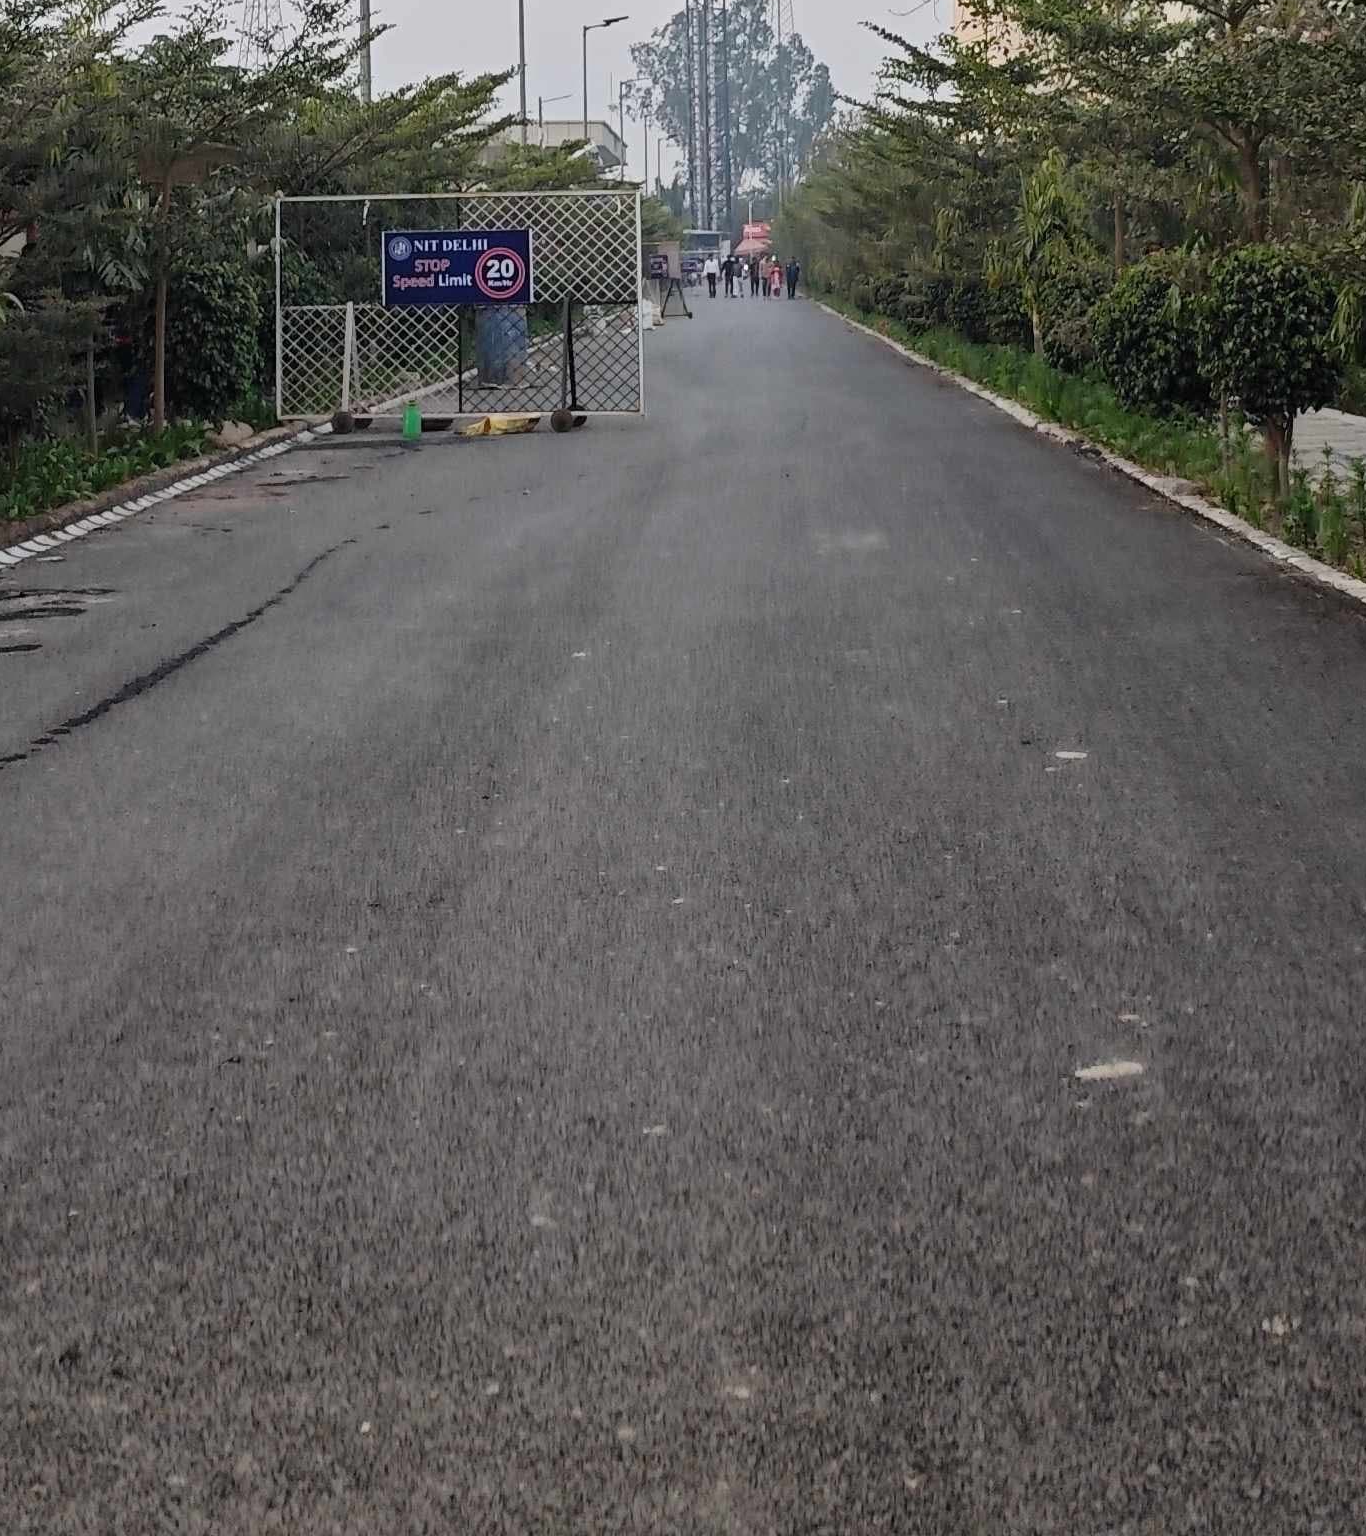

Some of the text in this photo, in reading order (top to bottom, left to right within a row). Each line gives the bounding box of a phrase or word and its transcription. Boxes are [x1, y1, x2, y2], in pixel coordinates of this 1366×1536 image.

[413, 238, 488, 252] NIT DELHI
[414, 259, 451, 272] STOP
[486, 259, 515, 278] 20
[392, 272, 473, 290] Speed Limit
